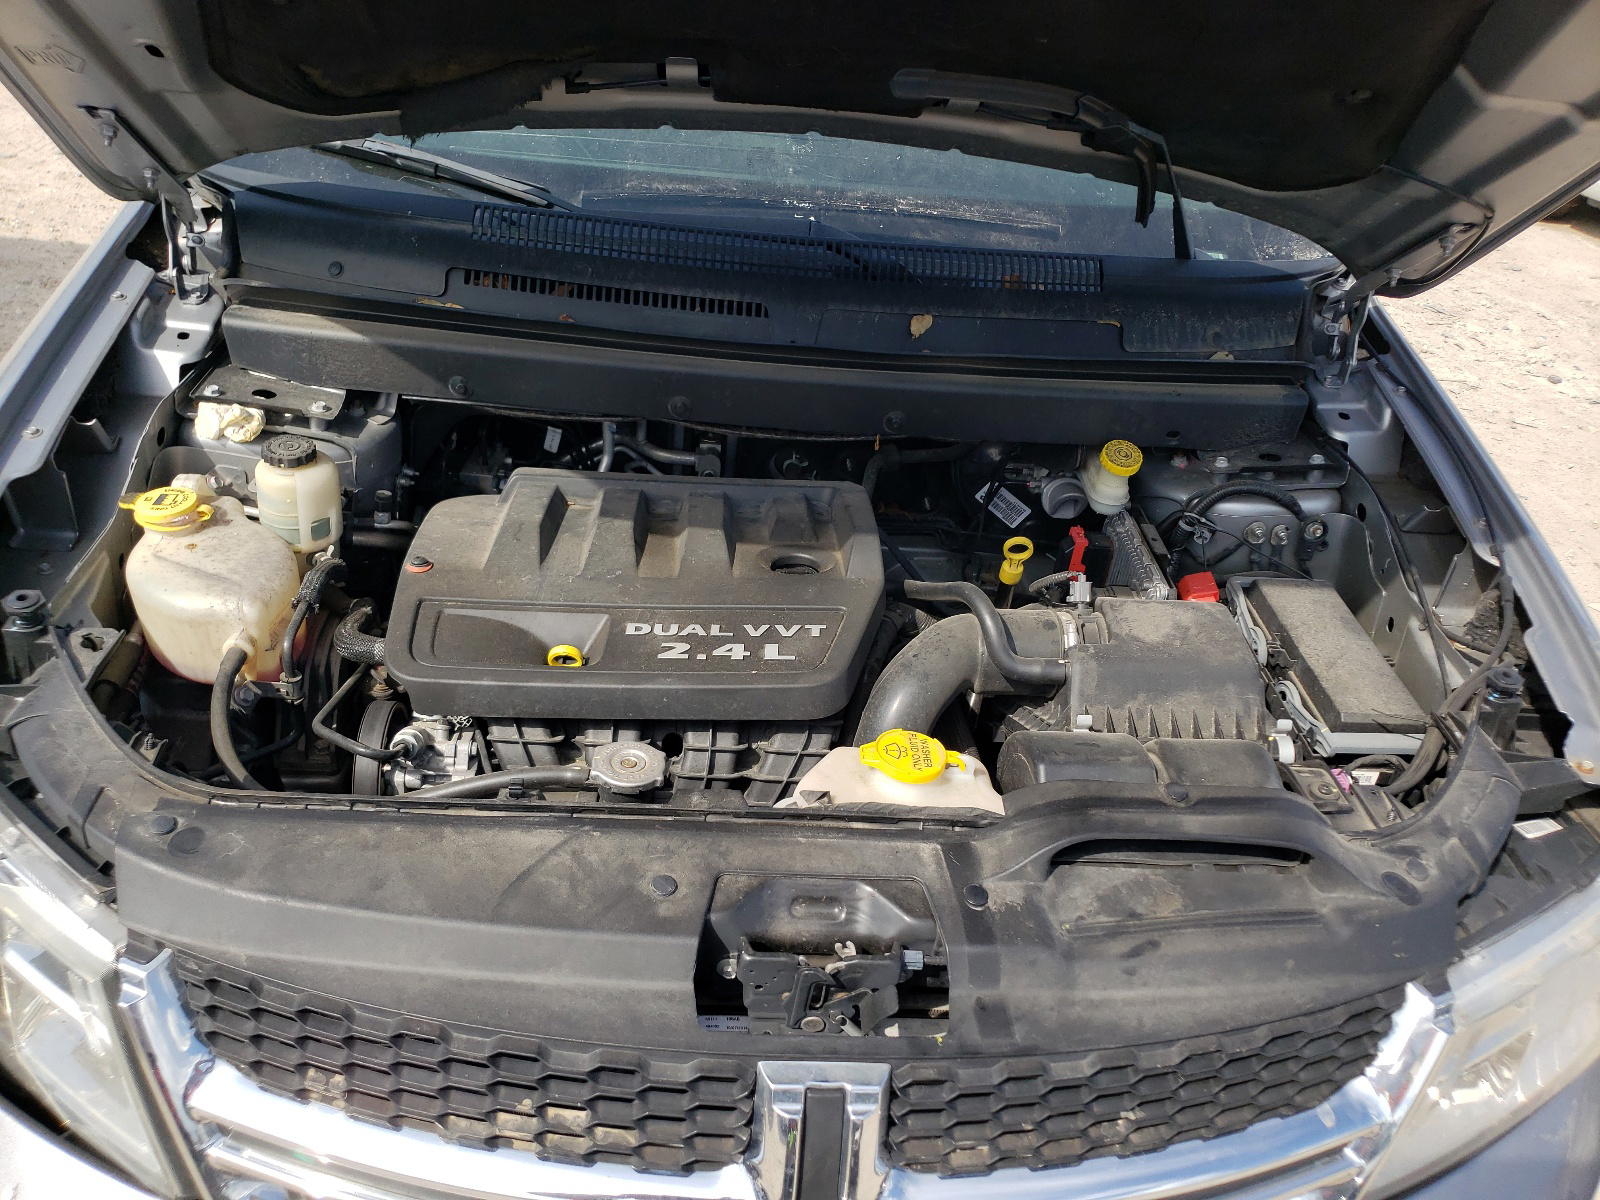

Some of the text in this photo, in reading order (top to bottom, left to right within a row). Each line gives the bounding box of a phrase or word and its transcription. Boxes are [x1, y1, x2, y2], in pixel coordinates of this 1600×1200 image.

[624, 622, 827, 638] DUAL VVT
[920, 739, 933, 768] WASHER
